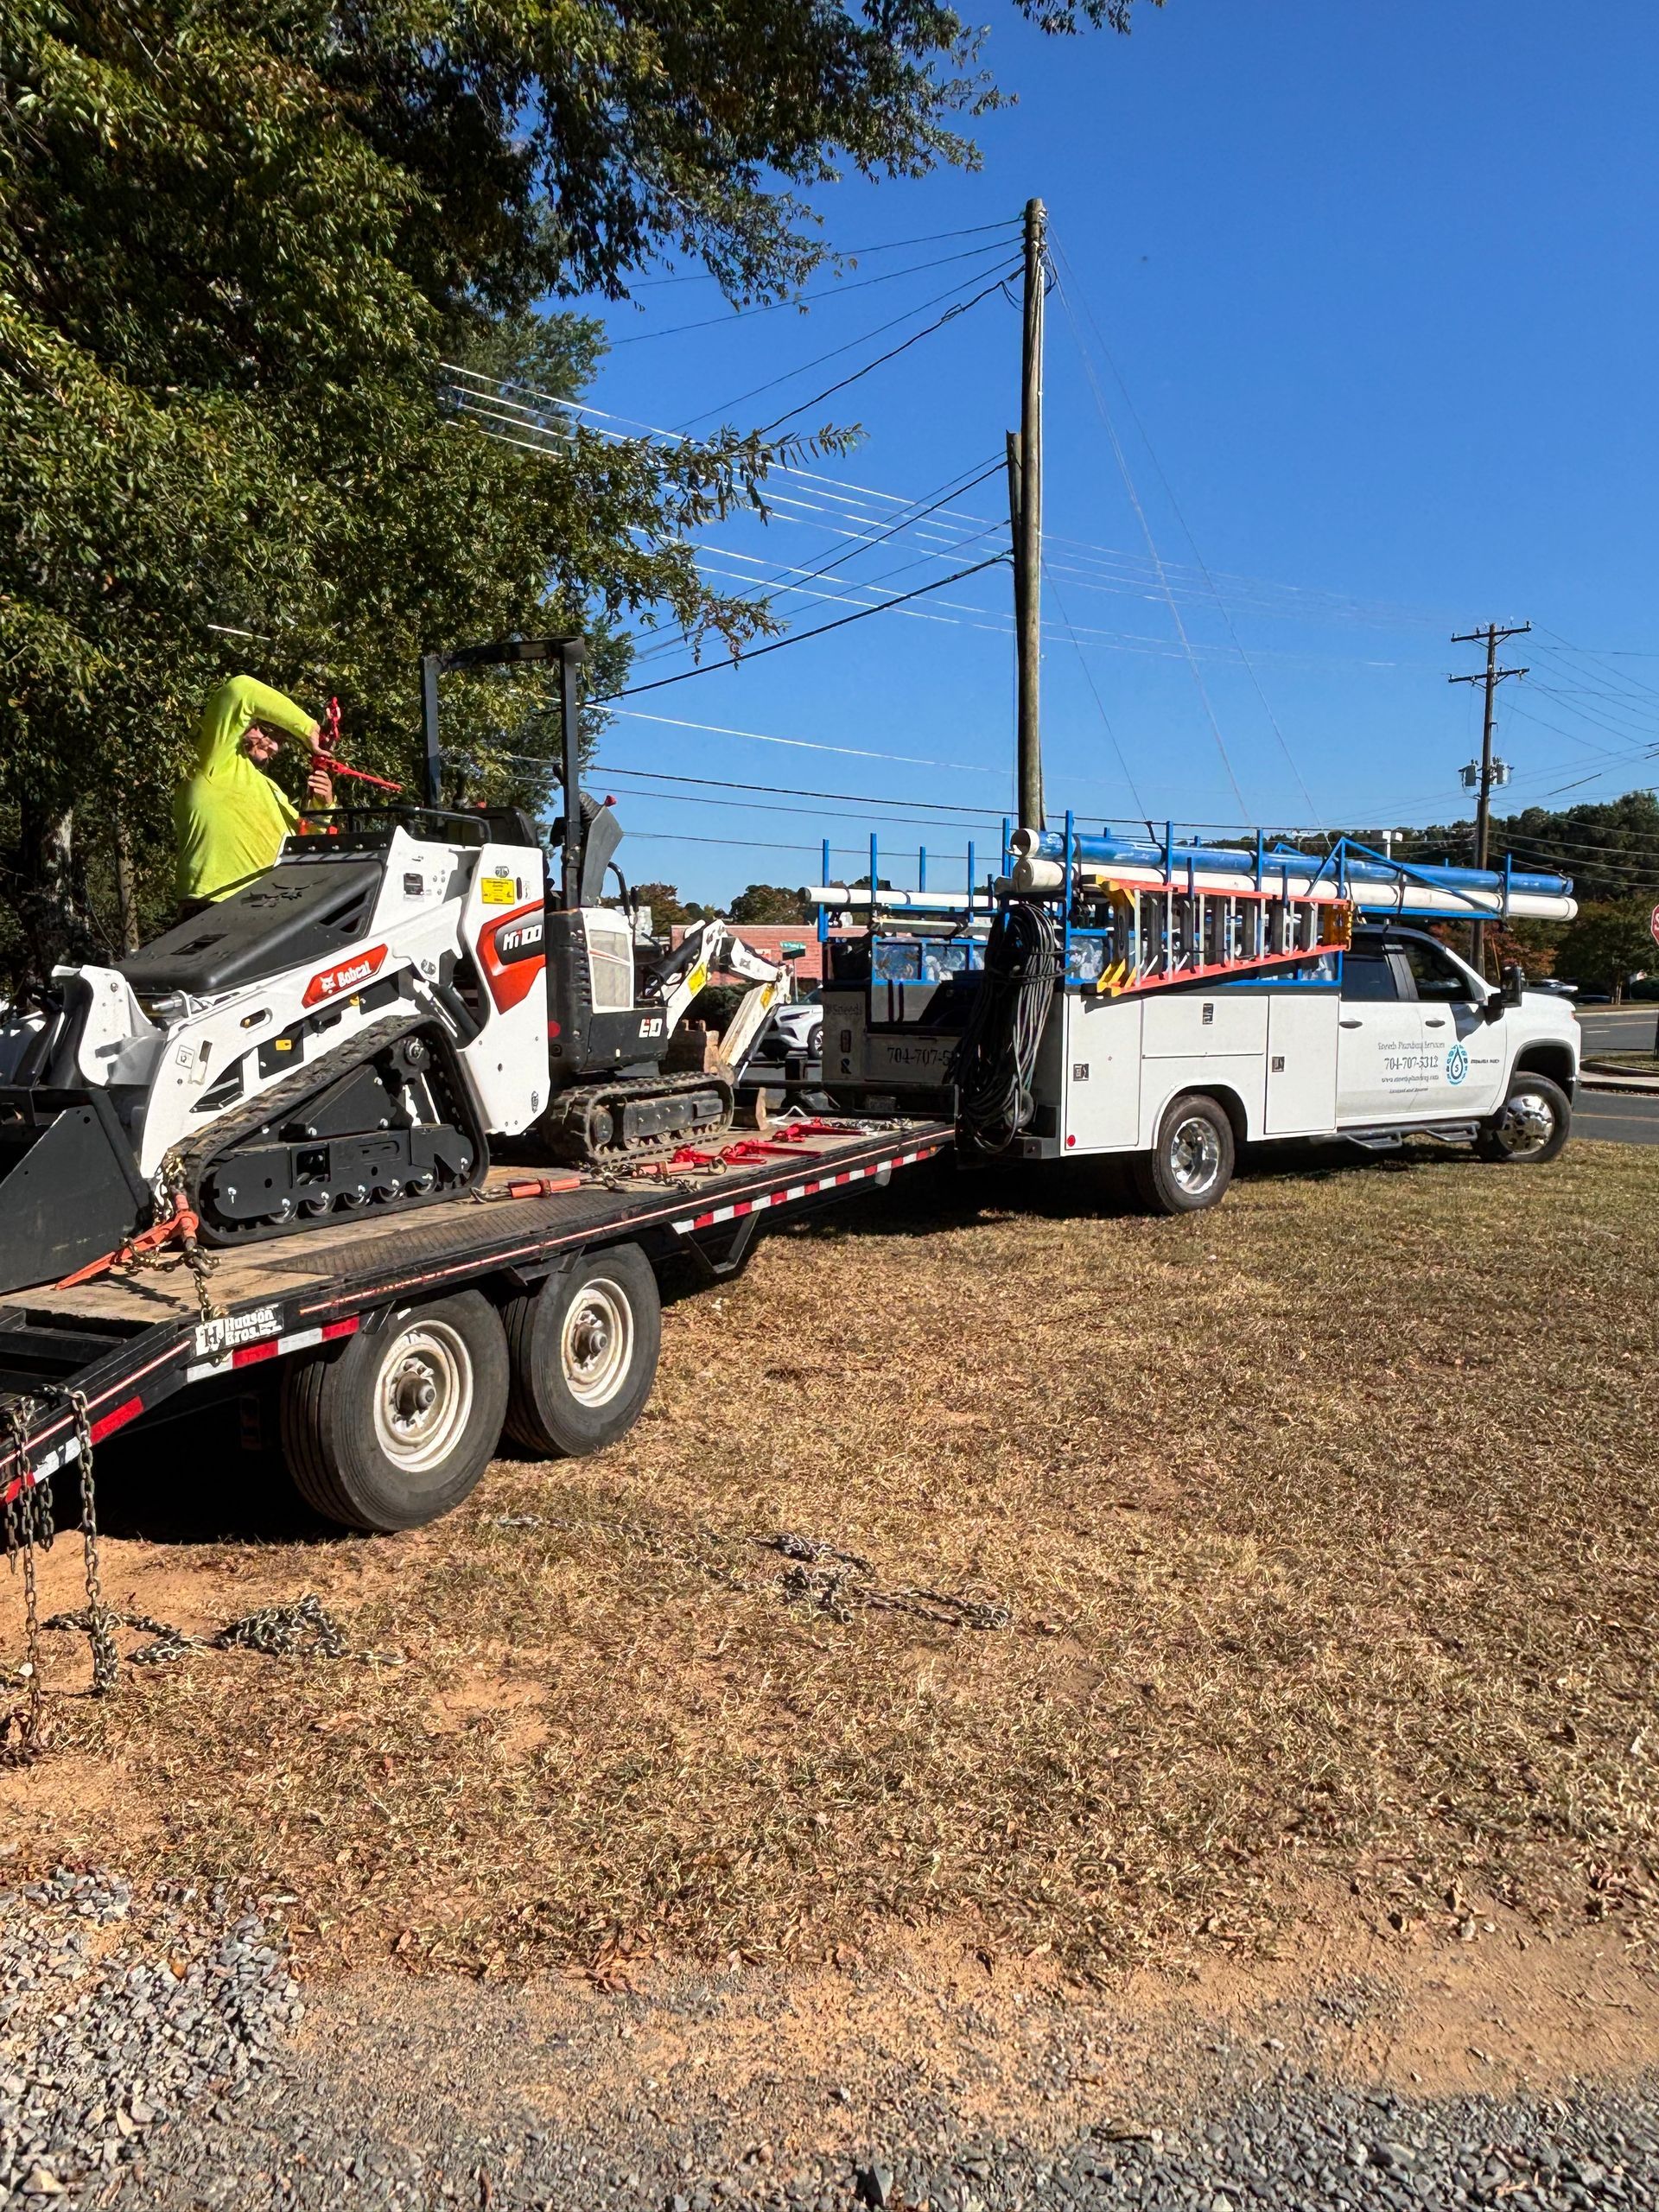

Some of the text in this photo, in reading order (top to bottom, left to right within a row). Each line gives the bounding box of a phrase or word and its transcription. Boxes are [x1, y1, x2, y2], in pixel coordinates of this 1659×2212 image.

[337, 960, 373, 987] Bobcat
[1384, 1055, 1439, 1071] 704-707-5312
[225, 1309, 275, 1332] Hudson
